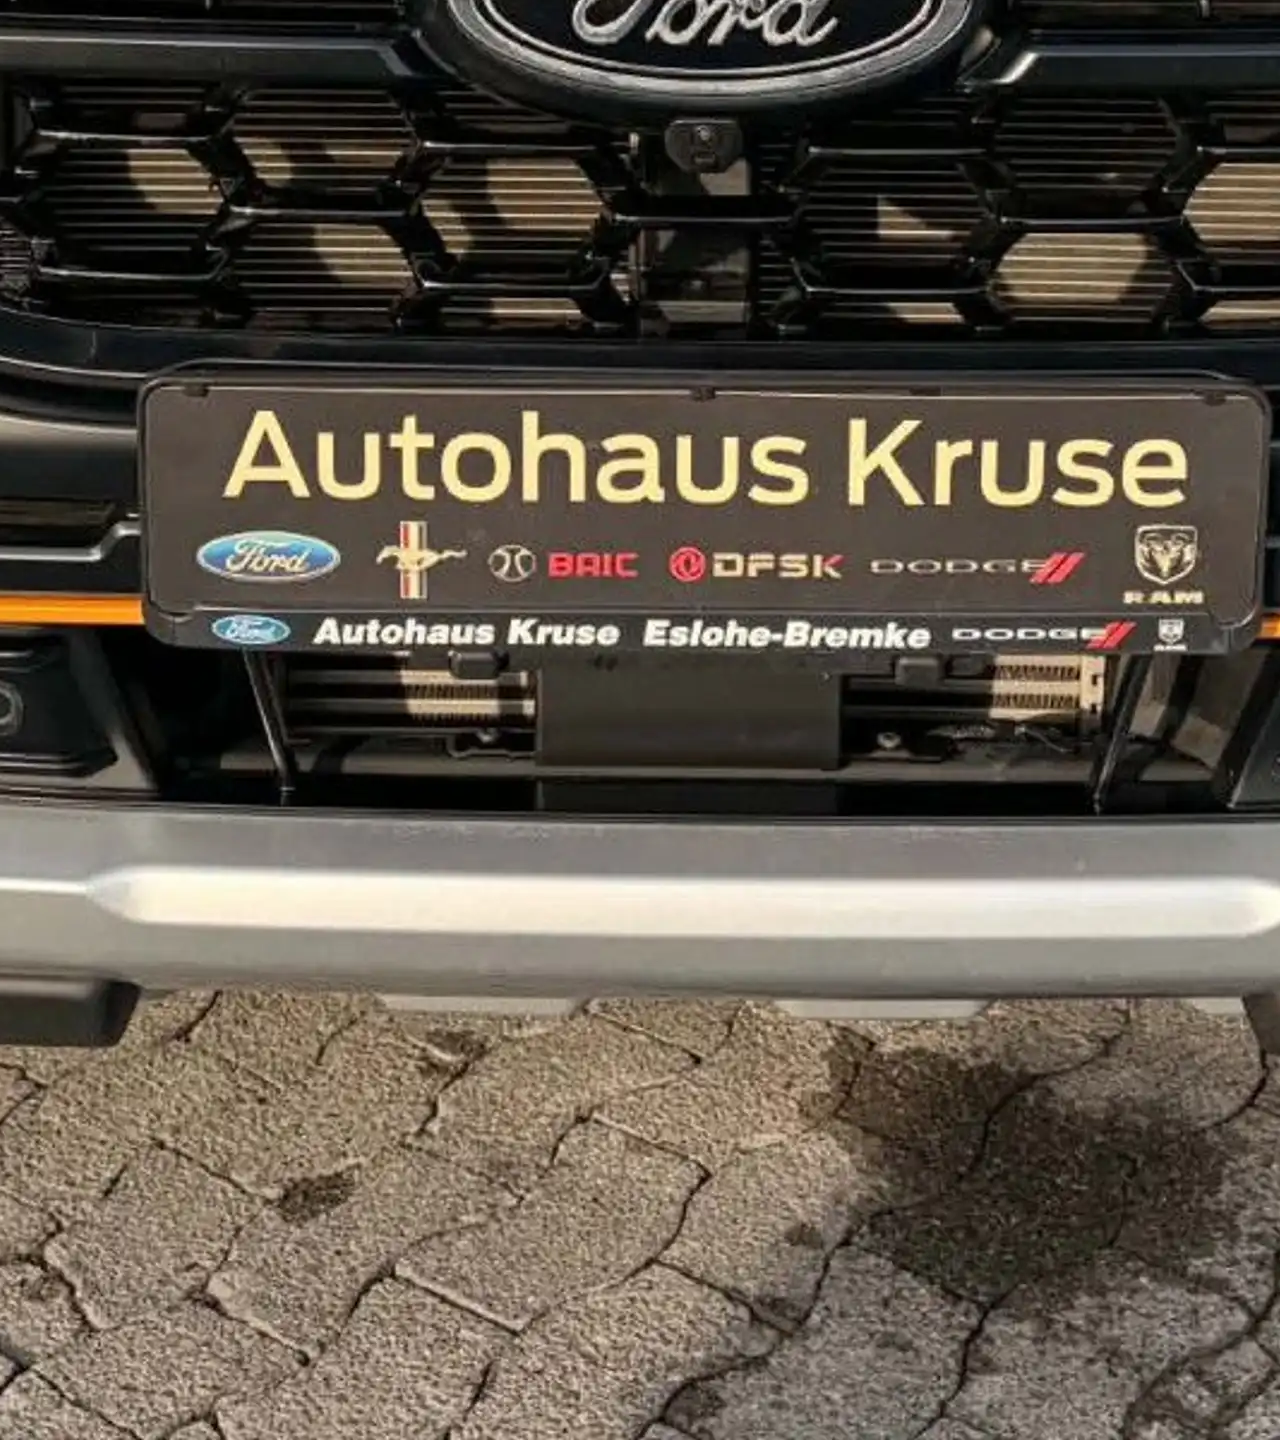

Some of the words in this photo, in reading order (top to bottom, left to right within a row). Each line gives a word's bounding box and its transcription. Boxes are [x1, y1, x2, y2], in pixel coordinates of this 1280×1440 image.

[222, 409, 810, 506] Autohaus
[846, 417, 1190, 508] Kruse
[548, 552, 638, 578] BAIC
[712, 553, 844, 579] DFSK
[870, 558, 1046, 575] DODGE
[1122, 590, 1204, 605] RAM
[313, 617, 495, 646] Autohaus
[508, 618, 620, 647] Kruse
[643, 620, 931, 649] Eslohe-Bremke
